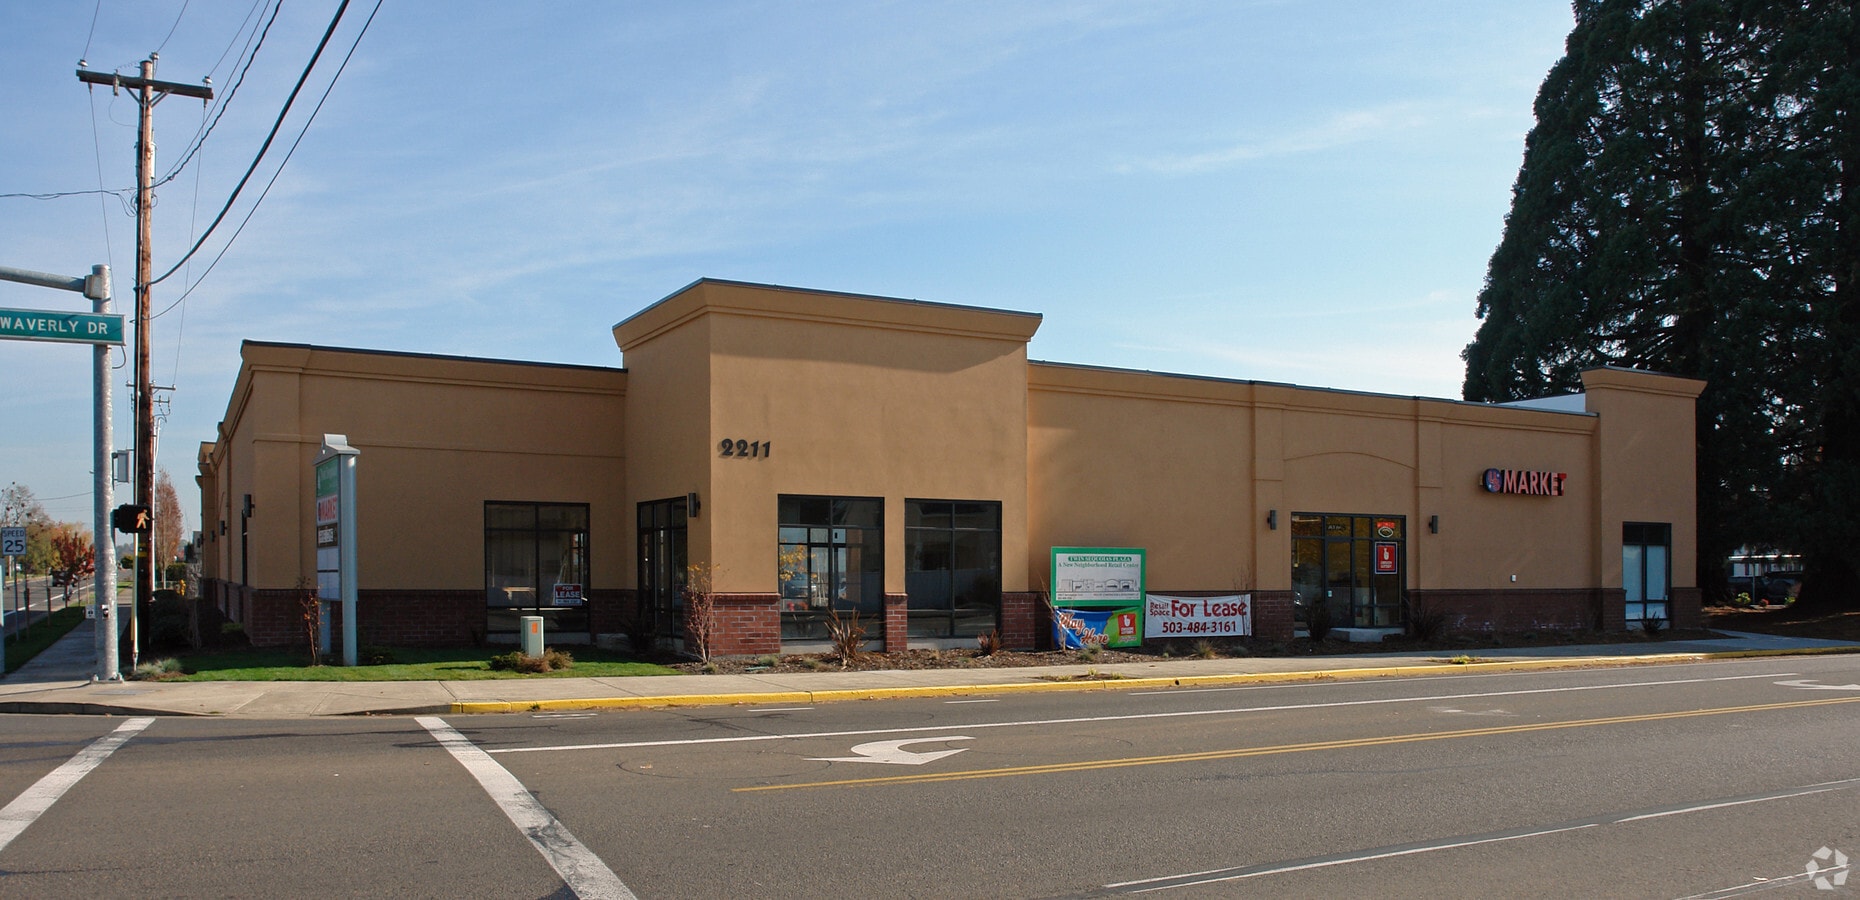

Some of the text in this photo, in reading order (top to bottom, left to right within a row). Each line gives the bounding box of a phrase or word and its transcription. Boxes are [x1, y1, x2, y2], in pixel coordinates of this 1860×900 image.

[0, 316, 108, 335] WAVERLY DR
[721, 438, 771, 458] 2211
[1503, 469, 1567, 496] MARKET
[4, 539, 24, 553] 25
[1149, 600, 1247, 617] Retail For Lease
[1149, 609, 1170, 617] Space
[1162, 621, 1237, 633] 503-484-3161
[1081, 627, 1109, 646] Here
